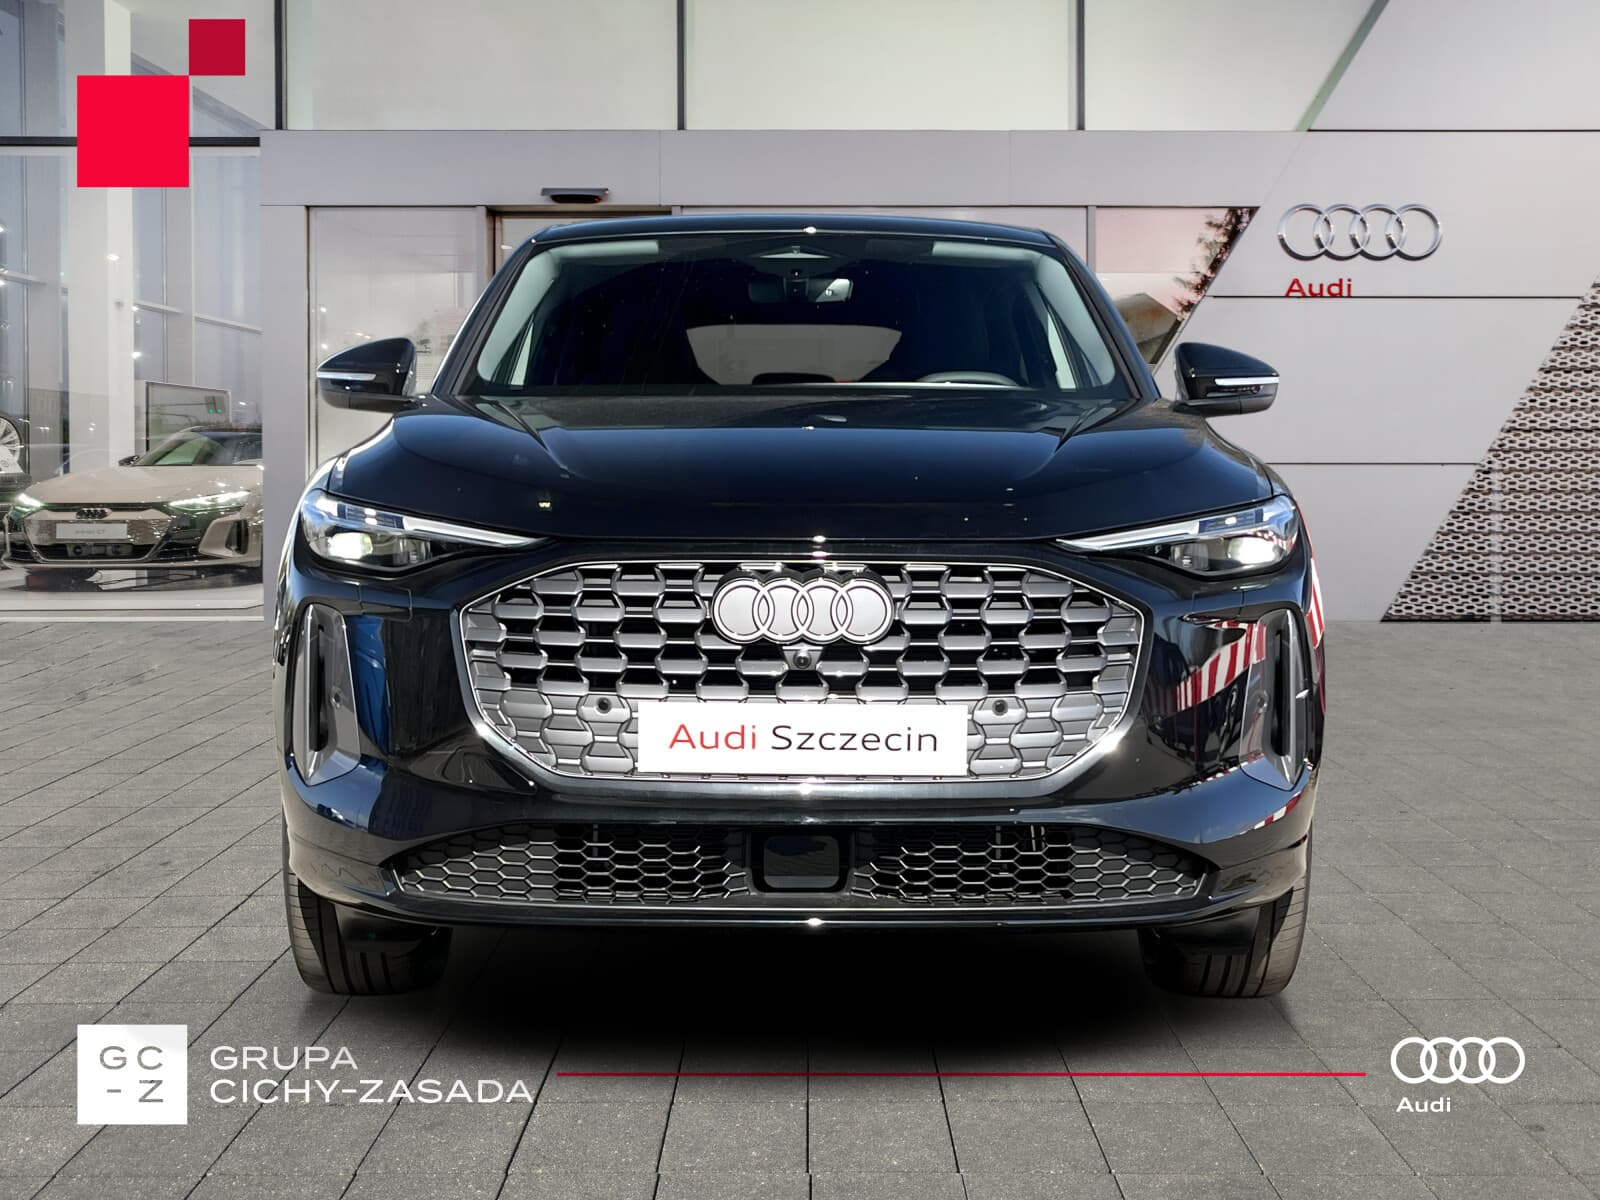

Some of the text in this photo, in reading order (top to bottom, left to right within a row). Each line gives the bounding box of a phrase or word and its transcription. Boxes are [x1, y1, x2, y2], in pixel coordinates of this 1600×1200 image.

[1285, 278, 1353, 297] Audi
[668, 724, 938, 752] Audi Szczecin
